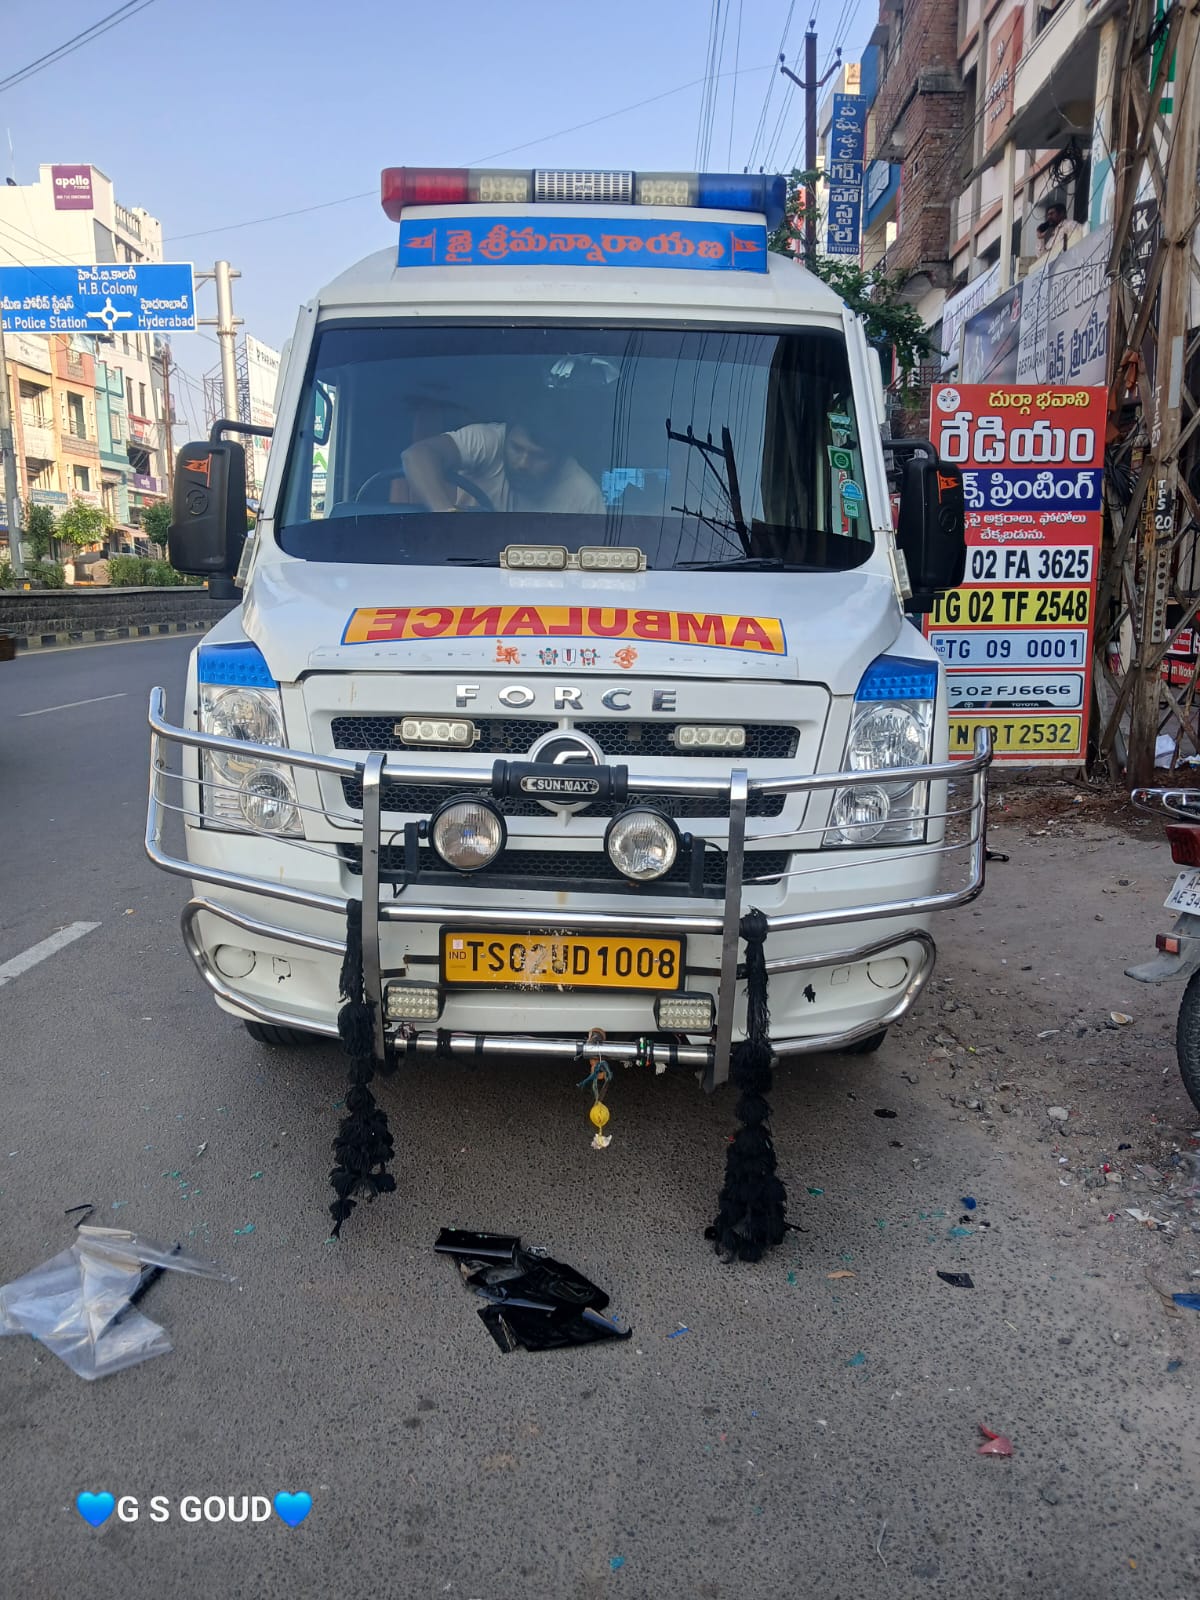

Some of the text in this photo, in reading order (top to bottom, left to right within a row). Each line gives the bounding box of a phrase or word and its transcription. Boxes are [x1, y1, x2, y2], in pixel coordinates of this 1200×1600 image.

[55, 174, 89, 189] apollo
[445, 224, 724, 263] జై శ్రీమన్నారాయణ
[78, 281, 138, 297] H.B.Colony
[140, 295, 188, 314] హైదరాబాద్
[14, 316, 46, 329] Police
[49, 315, 88, 329] Station
[138, 314, 194, 330] Hyderabad
[988, 390, 1090, 415] దుర్గా భవాని
[940, 411, 1095, 463] రేడియం
[990, 471, 1095, 507] ప్రింటింగ్
[972, 549, 1089, 580] 02 FA 3625
[933, 590, 1088, 623] TG 02 TF 2548
[945, 639, 1078, 658] TG 09 0001
[455, 683, 677, 712] FORCE
[1019, 723, 1072, 744] 2532
[537, 779, 589, 792] SUN-MAX
[449, 951, 467, 960] IND
